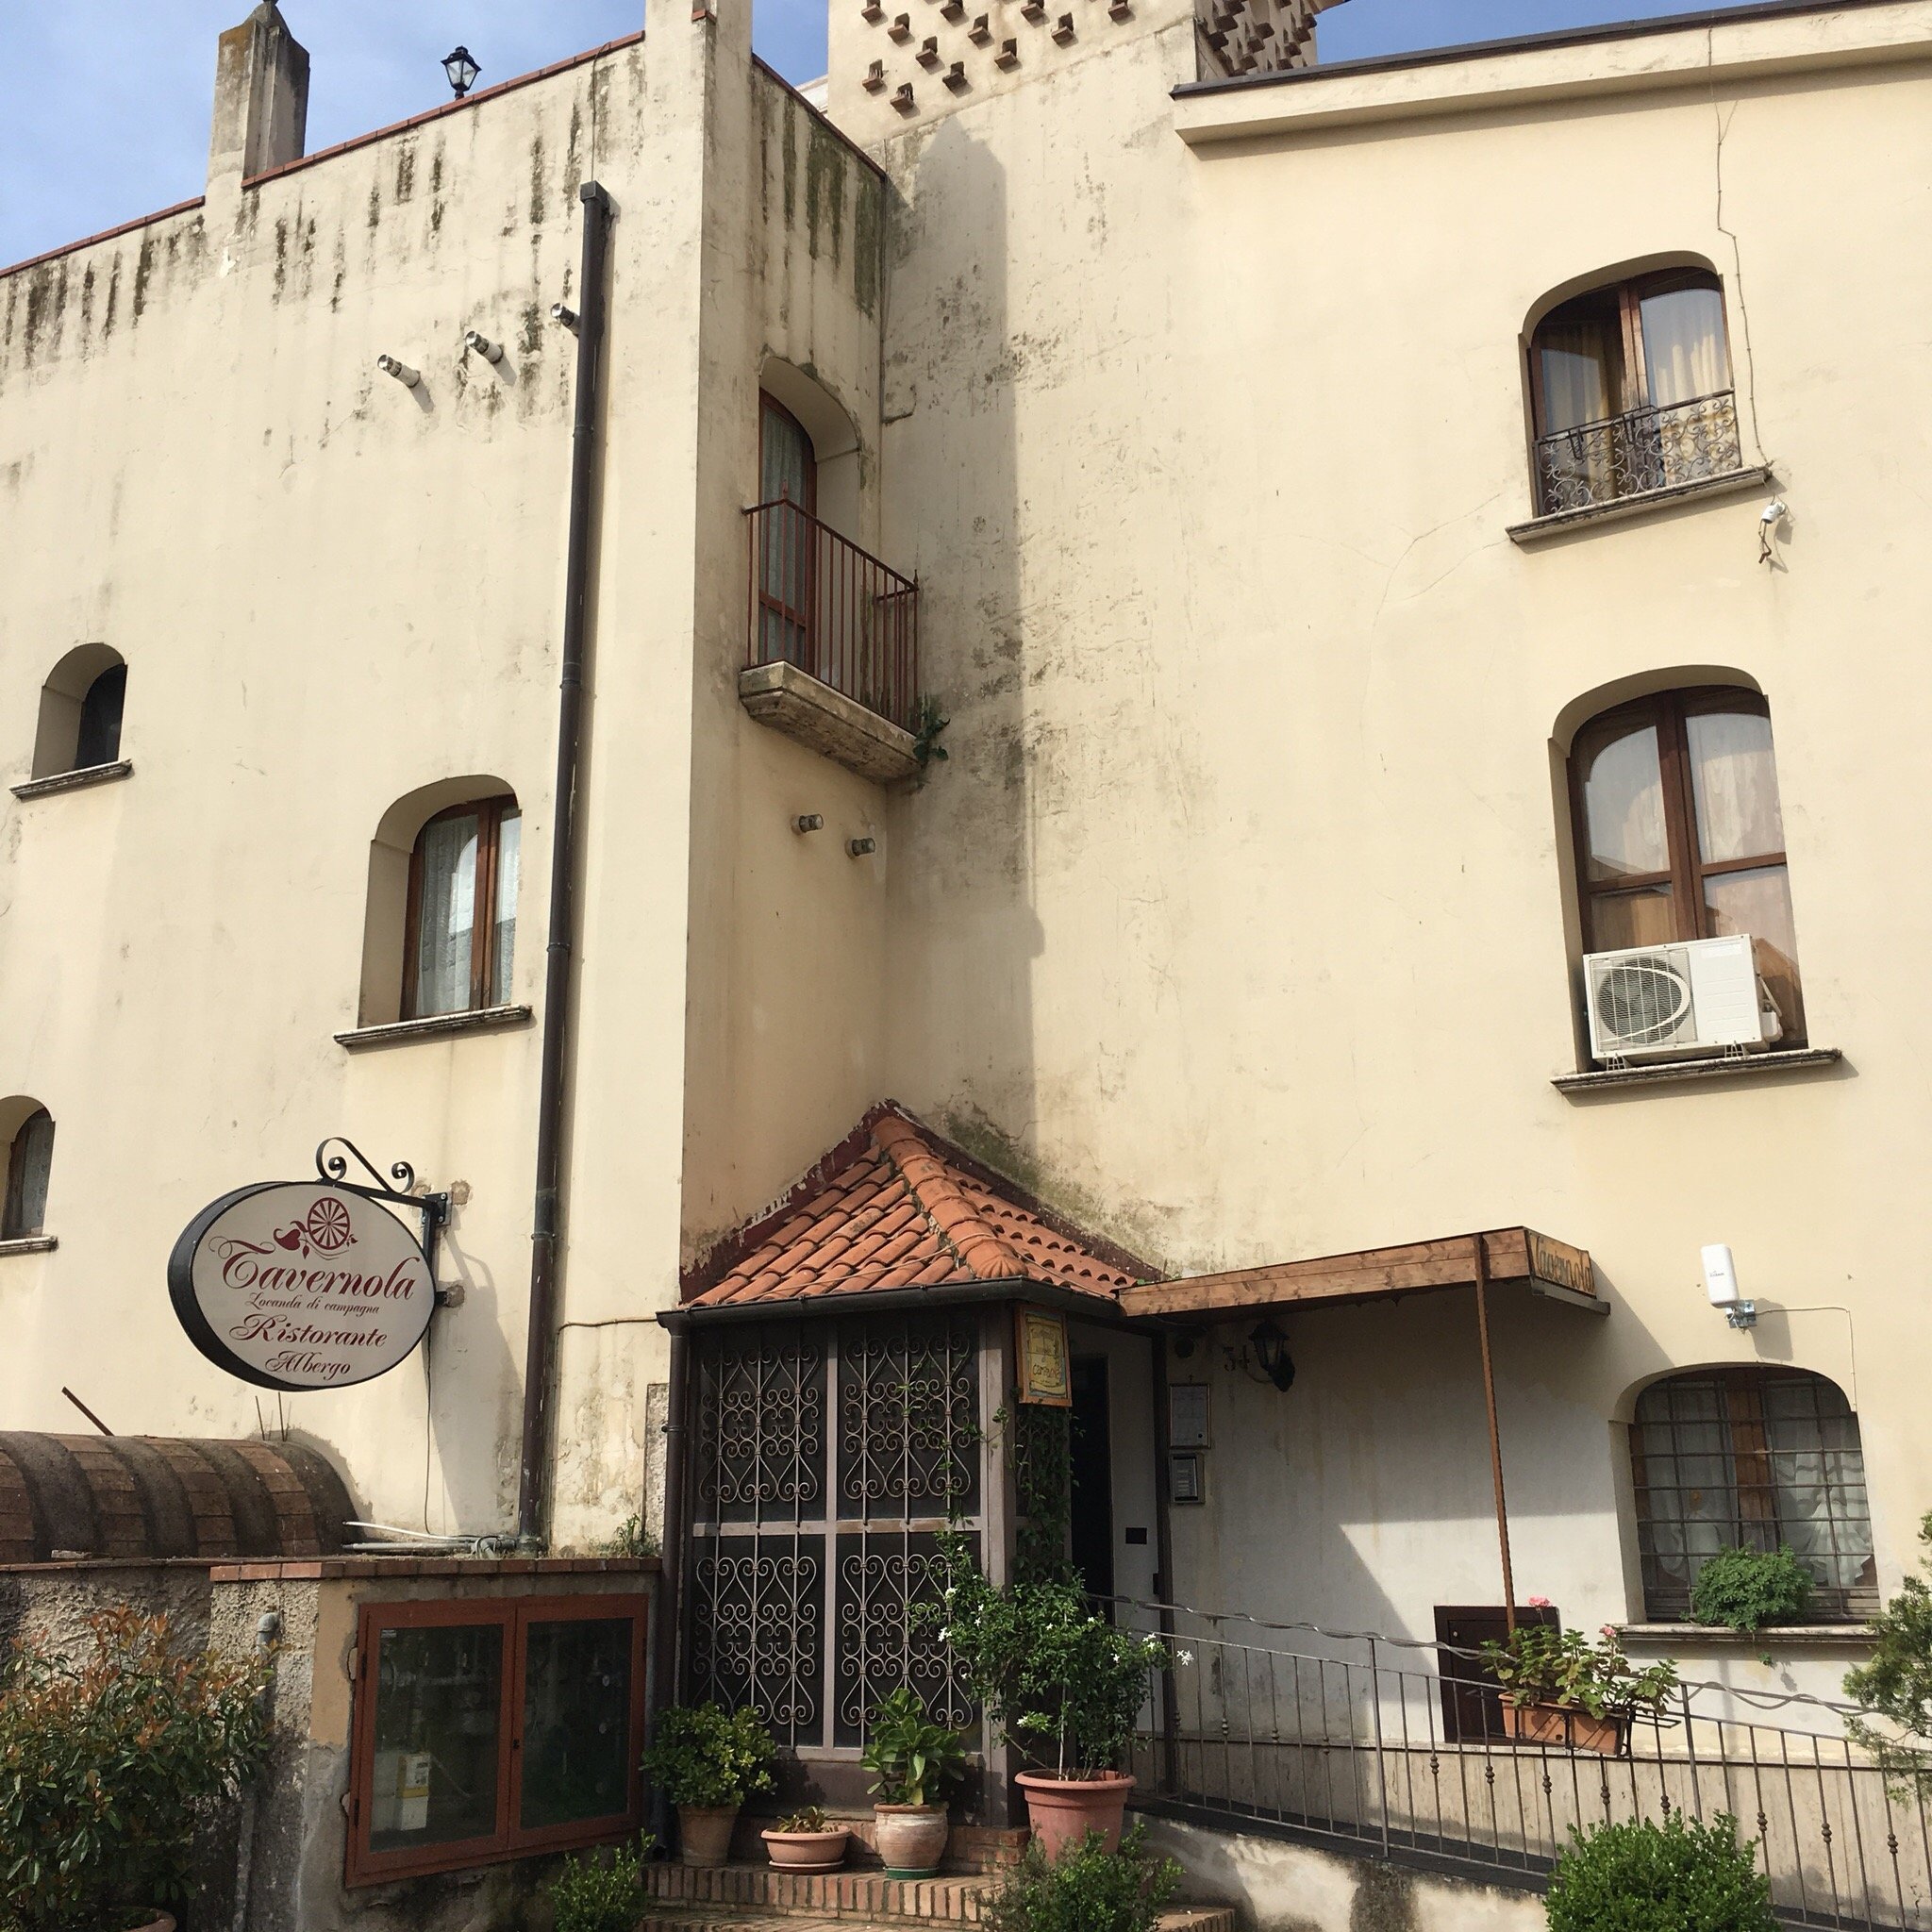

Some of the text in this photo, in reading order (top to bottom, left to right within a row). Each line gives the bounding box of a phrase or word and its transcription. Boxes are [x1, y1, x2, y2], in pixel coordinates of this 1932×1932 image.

[208, 1235, 421, 1301] Tavernola
[244, 1291, 380, 1318] Locanda di campagna
[228, 1313, 388, 1348] Ristorante
[264, 1350, 352, 1381] Albergo
